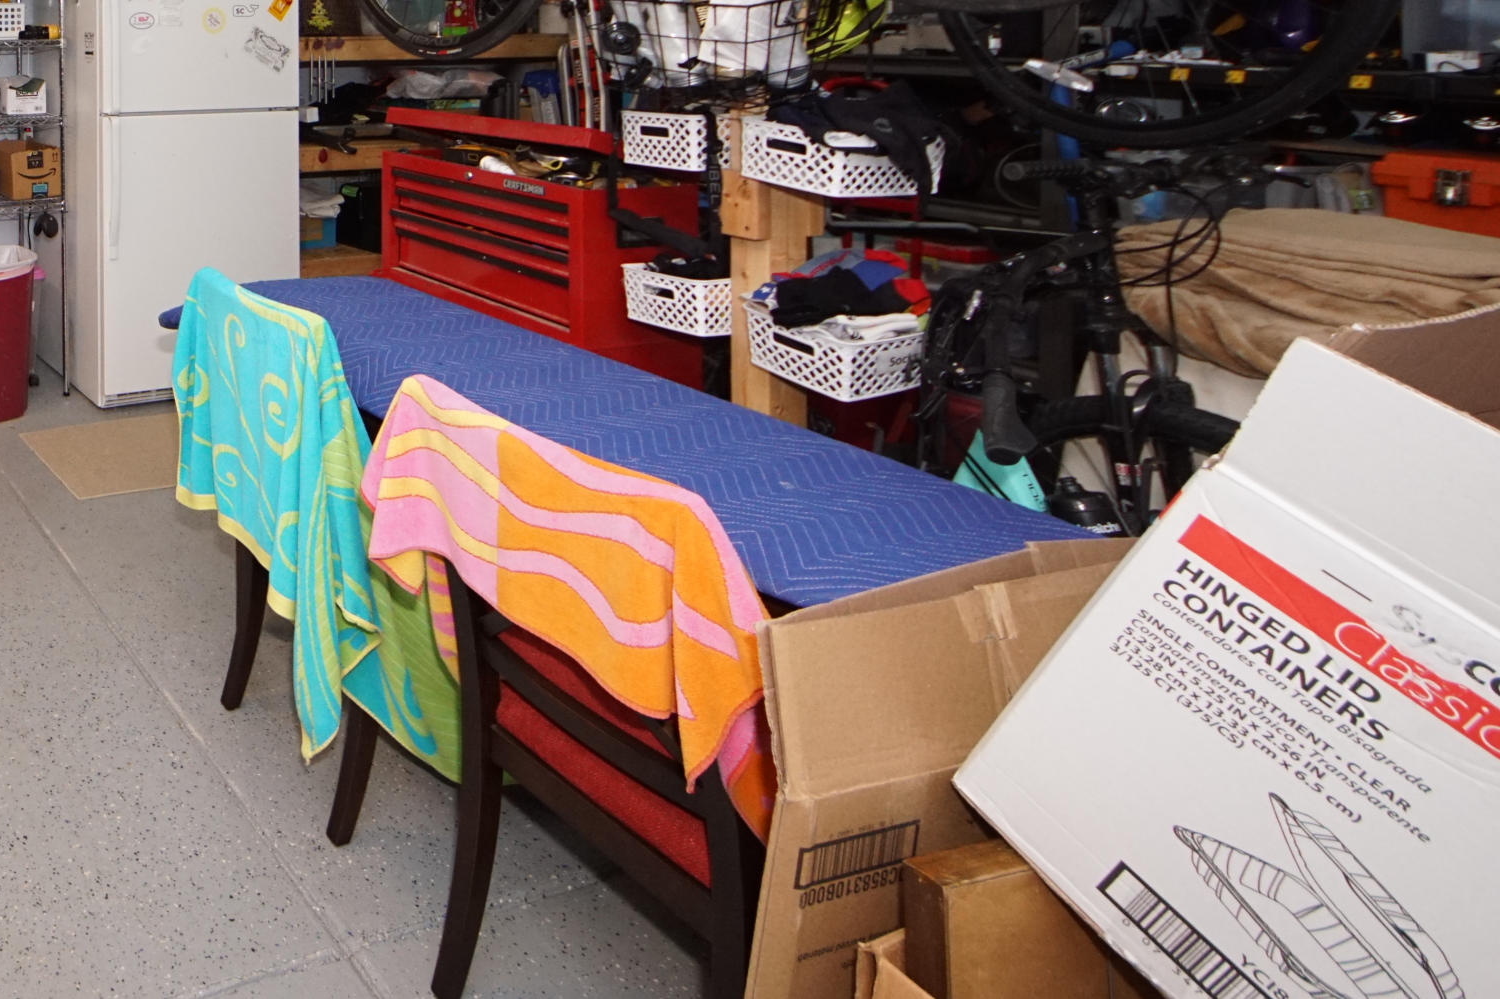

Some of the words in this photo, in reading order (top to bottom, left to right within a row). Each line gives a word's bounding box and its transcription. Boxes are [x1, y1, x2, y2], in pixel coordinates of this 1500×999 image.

[1108, 641, 1153, 678] 3/125
[1153, 676, 1177, 695] CT
[1176, 694, 1246, 750] (375/CS)
[1123, 626, 1157, 653] 5.23
[1158, 652, 1177, 668] IN
[1191, 676, 1227, 704] 5.25
[1227, 703, 1248, 721] IN
[1261, 730, 1302, 761] 2.56
[1303, 761, 1326, 780] IN
[1137, 608, 1195, 653] SINGLE
[1195, 651, 1335, 752] COMPARTMENT
[1346, 761, 1412, 812] CLEAR
[1152, 592, 1256, 668] Contenedores
[1257, 668, 1288, 691] con
[1291, 688, 1335, 724] Tapa
[1336, 723, 1433, 794] Bisagrada
[1163, 579, 1390, 741] CONTAINERS
[1176, 559, 1311, 656] HINGED
[1315, 654, 1381, 704] LID
[1116, 634, 1165, 672] (13.28
[1164, 671, 1189, 692] cm
[1204, 700, 1250, 738] 13.33
[1251, 737, 1278, 762] cm
[1294, 769, 1325, 794] 6.5
[1325, 794, 1363, 823] cm)
[1131, 618, 1246, 706] Compartimento
[1308, 749, 1432, 844] Transparente
